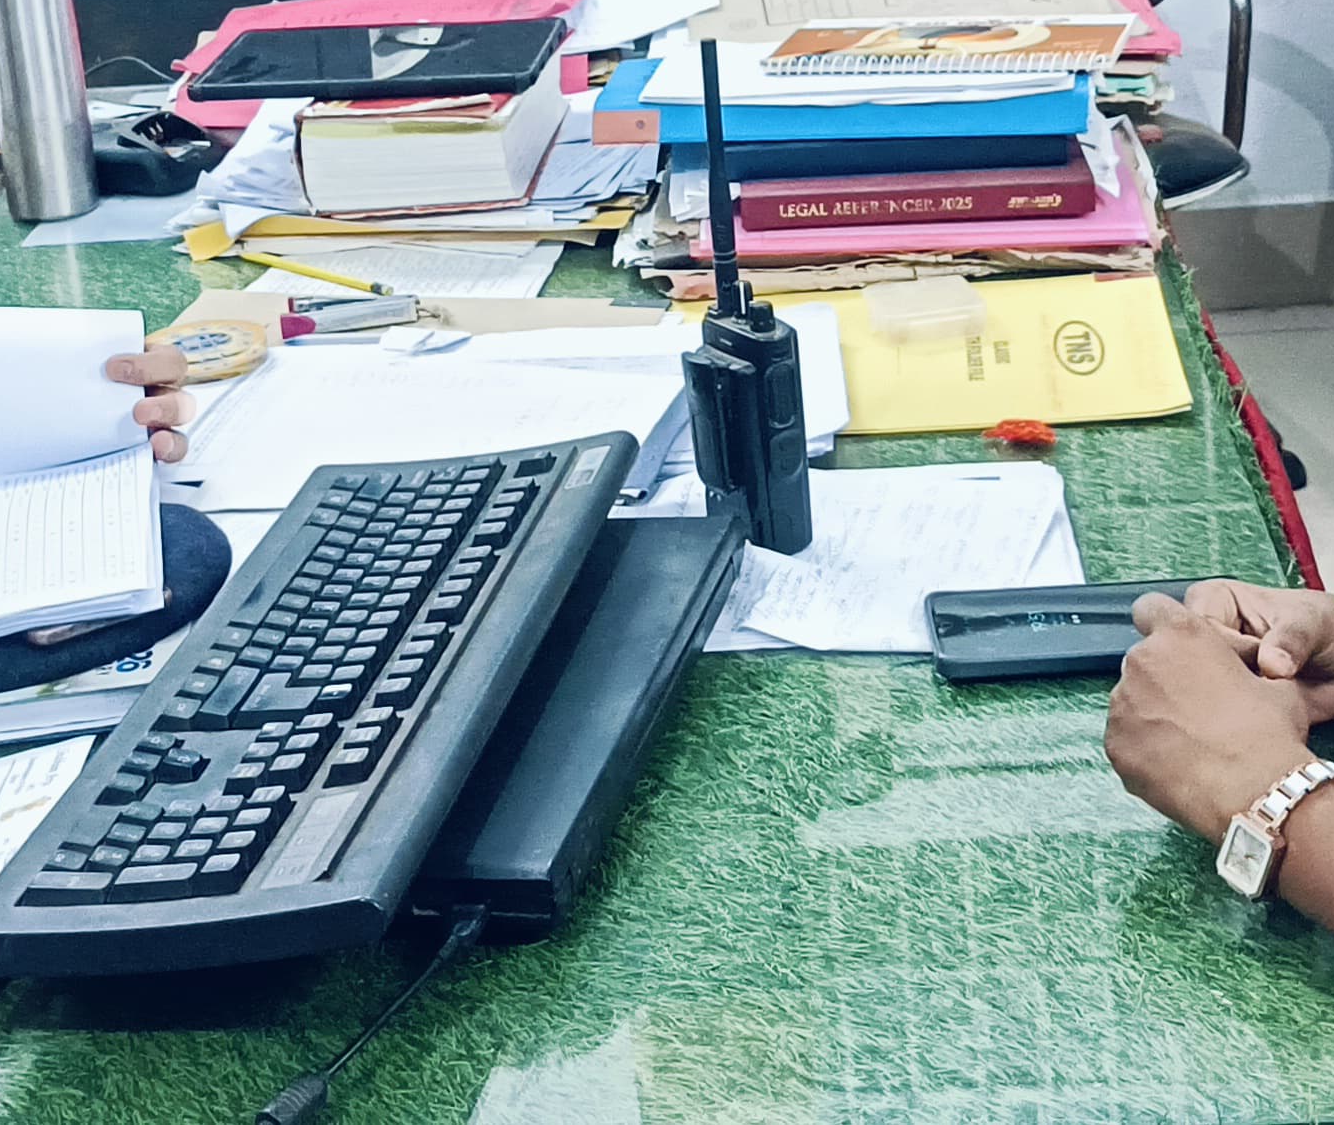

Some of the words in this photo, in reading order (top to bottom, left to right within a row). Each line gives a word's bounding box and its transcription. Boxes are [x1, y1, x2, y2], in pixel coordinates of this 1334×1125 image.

[778, 203, 828, 218] LEGAL
[832, 198, 936, 216] REFERNCER
[1062, 331, 1095, 364] TNS
